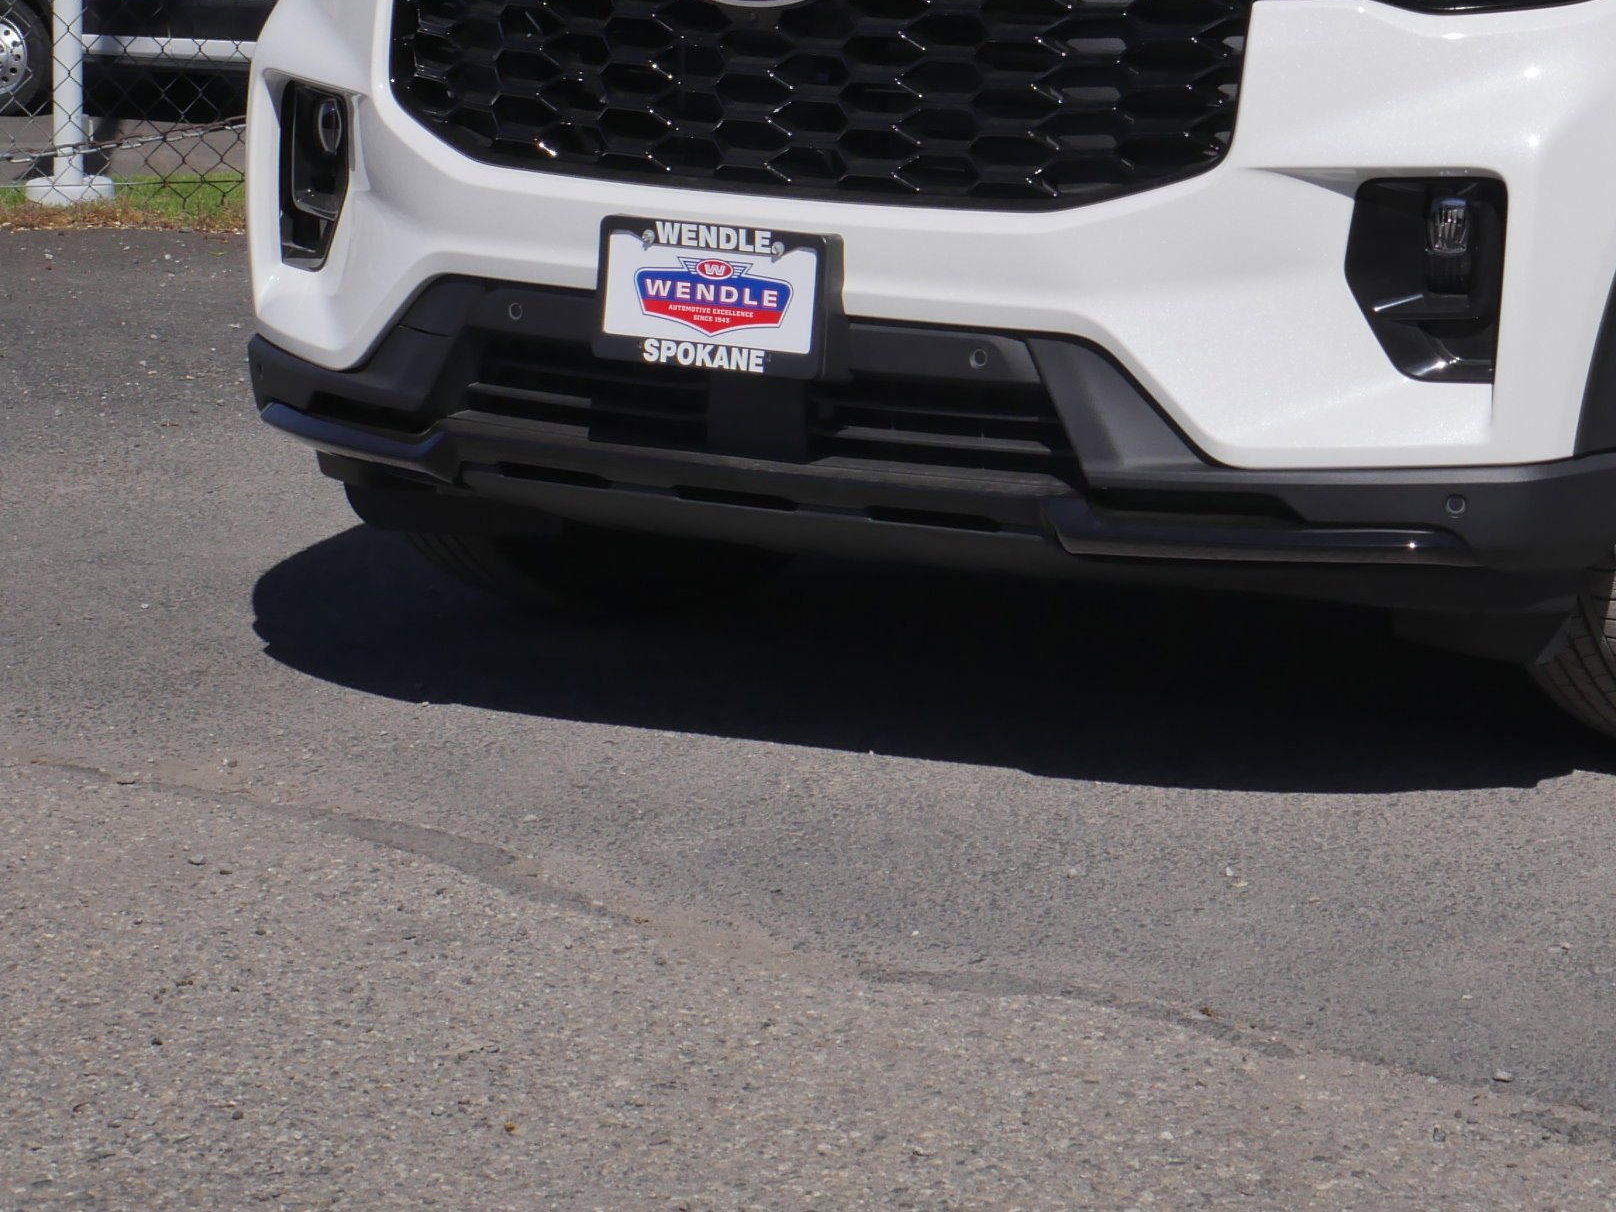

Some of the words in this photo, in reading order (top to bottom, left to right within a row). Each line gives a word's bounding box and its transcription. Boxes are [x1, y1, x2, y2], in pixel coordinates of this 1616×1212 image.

[655, 220, 772, 255] WENDLE
[645, 279, 778, 308] WENDLE
[668, 304, 711, 314] AUTOMOTIVE
[712, 308, 754, 318] EXCELLENCE
[693, 314, 713, 322] SINCE
[714, 316, 730, 324] 1943
[642, 339, 765, 373] SPOKANE
